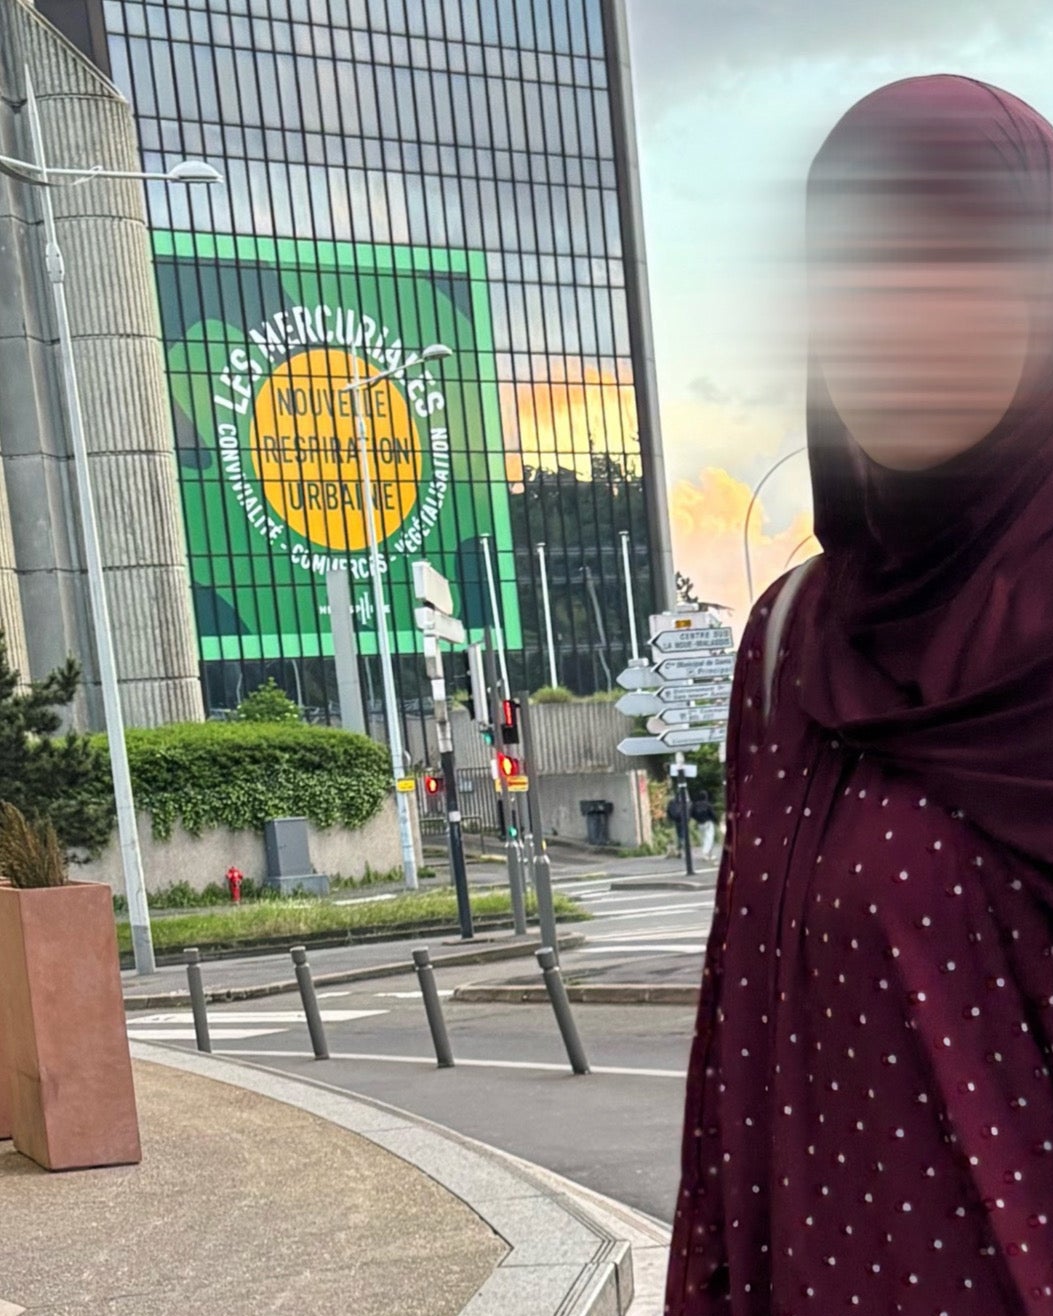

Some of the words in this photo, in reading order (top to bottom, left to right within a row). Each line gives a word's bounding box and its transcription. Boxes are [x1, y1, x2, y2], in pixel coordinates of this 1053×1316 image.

[213, 347, 263, 415] LES
[248, 304, 445, 418] MERCURIALES
[276, 387, 387, 418] NOUVELLE
[217, 423, 284, 546] CONVIVIALITÉ
[394, 427, 450, 557] VÉGÉTALISATION
[287, 483, 395, 510] URBAINE
